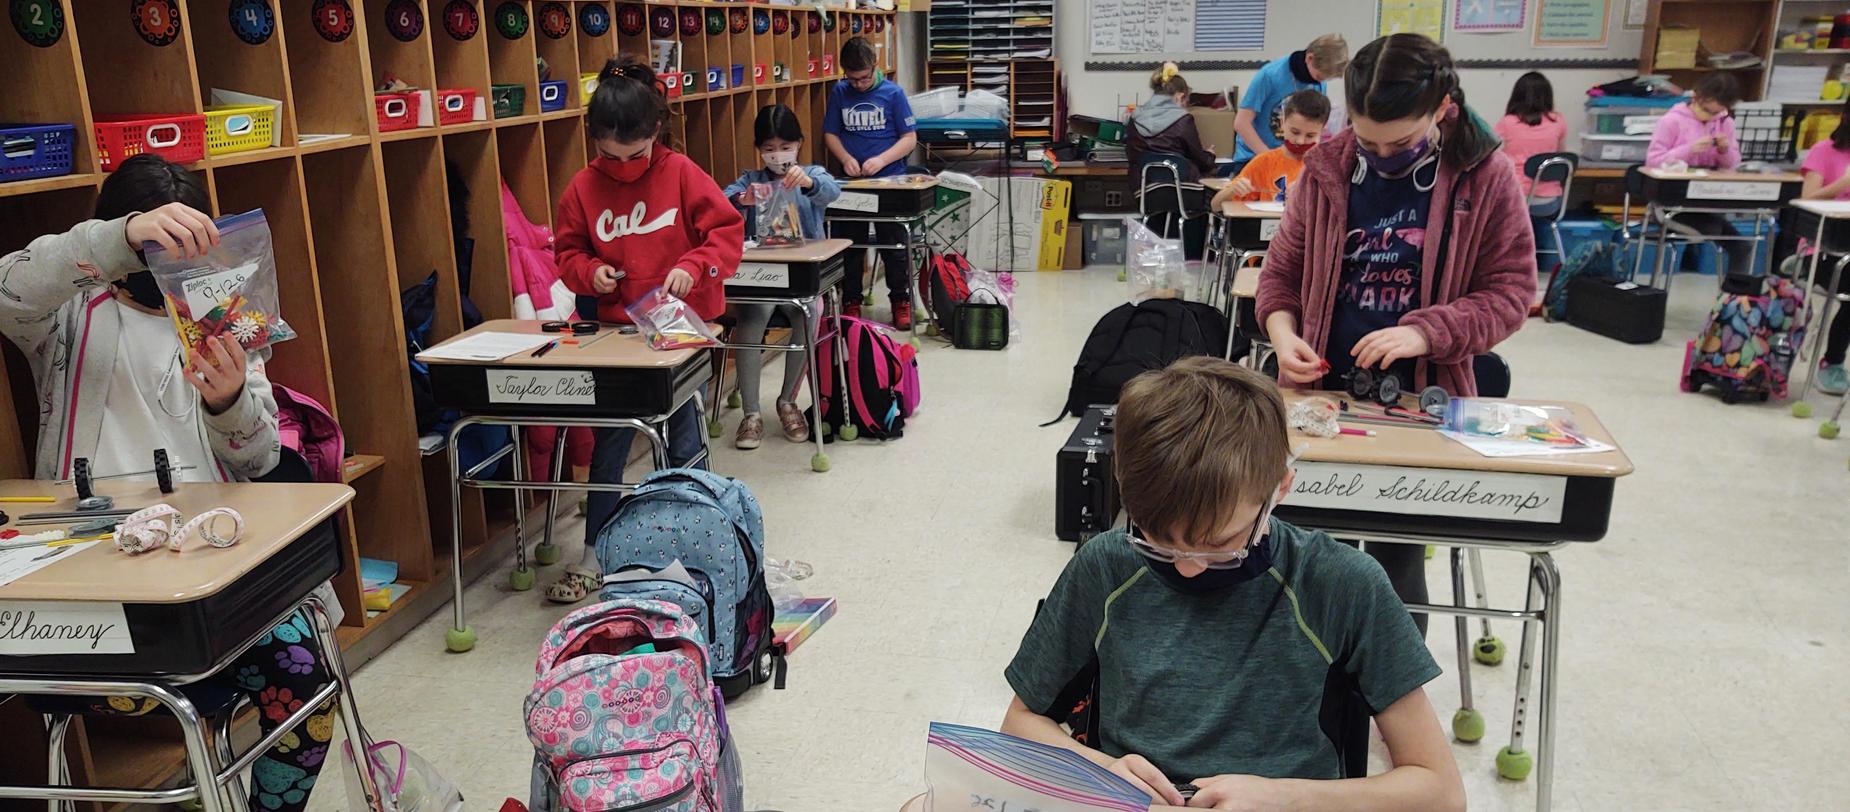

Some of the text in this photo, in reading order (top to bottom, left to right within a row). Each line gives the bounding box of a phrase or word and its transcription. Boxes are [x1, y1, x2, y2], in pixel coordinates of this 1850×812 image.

[30, 3, 44, 26] 2
[149, 7, 162, 26] 3
[245, 9, 257, 26] 4
[328, 10, 339, 26] 5
[400, 11, 410, 27] 6
[455, 12, 464, 27] 7
[507, 13, 516, 27] 8
[551, 13, 559, 27] 9
[588, 14, 602, 26] 10
[627, 14, 637, 25] 11
[684, 16, 695, 26] 13
[709, 16, 720, 27] 14
[731, 15, 742, 26] 15
[754, 17, 764, 27] 16
[658, 17, 670, 28] 12
[596, 201, 679, 243] Cal
[1374, 209, 1417, 229] JUST A
[1343, 227, 1393, 262] Girl
[1370, 252, 1399, 263] WHO
[751, 267, 784, 282] Liao
[185, 278, 208, 293] Ziploc
[496, 375, 597, 401] Taylor Cline
[1294, 470, 1549, 515] sabel Schildkamp
[0, 610, 115, 650] Elhaney
